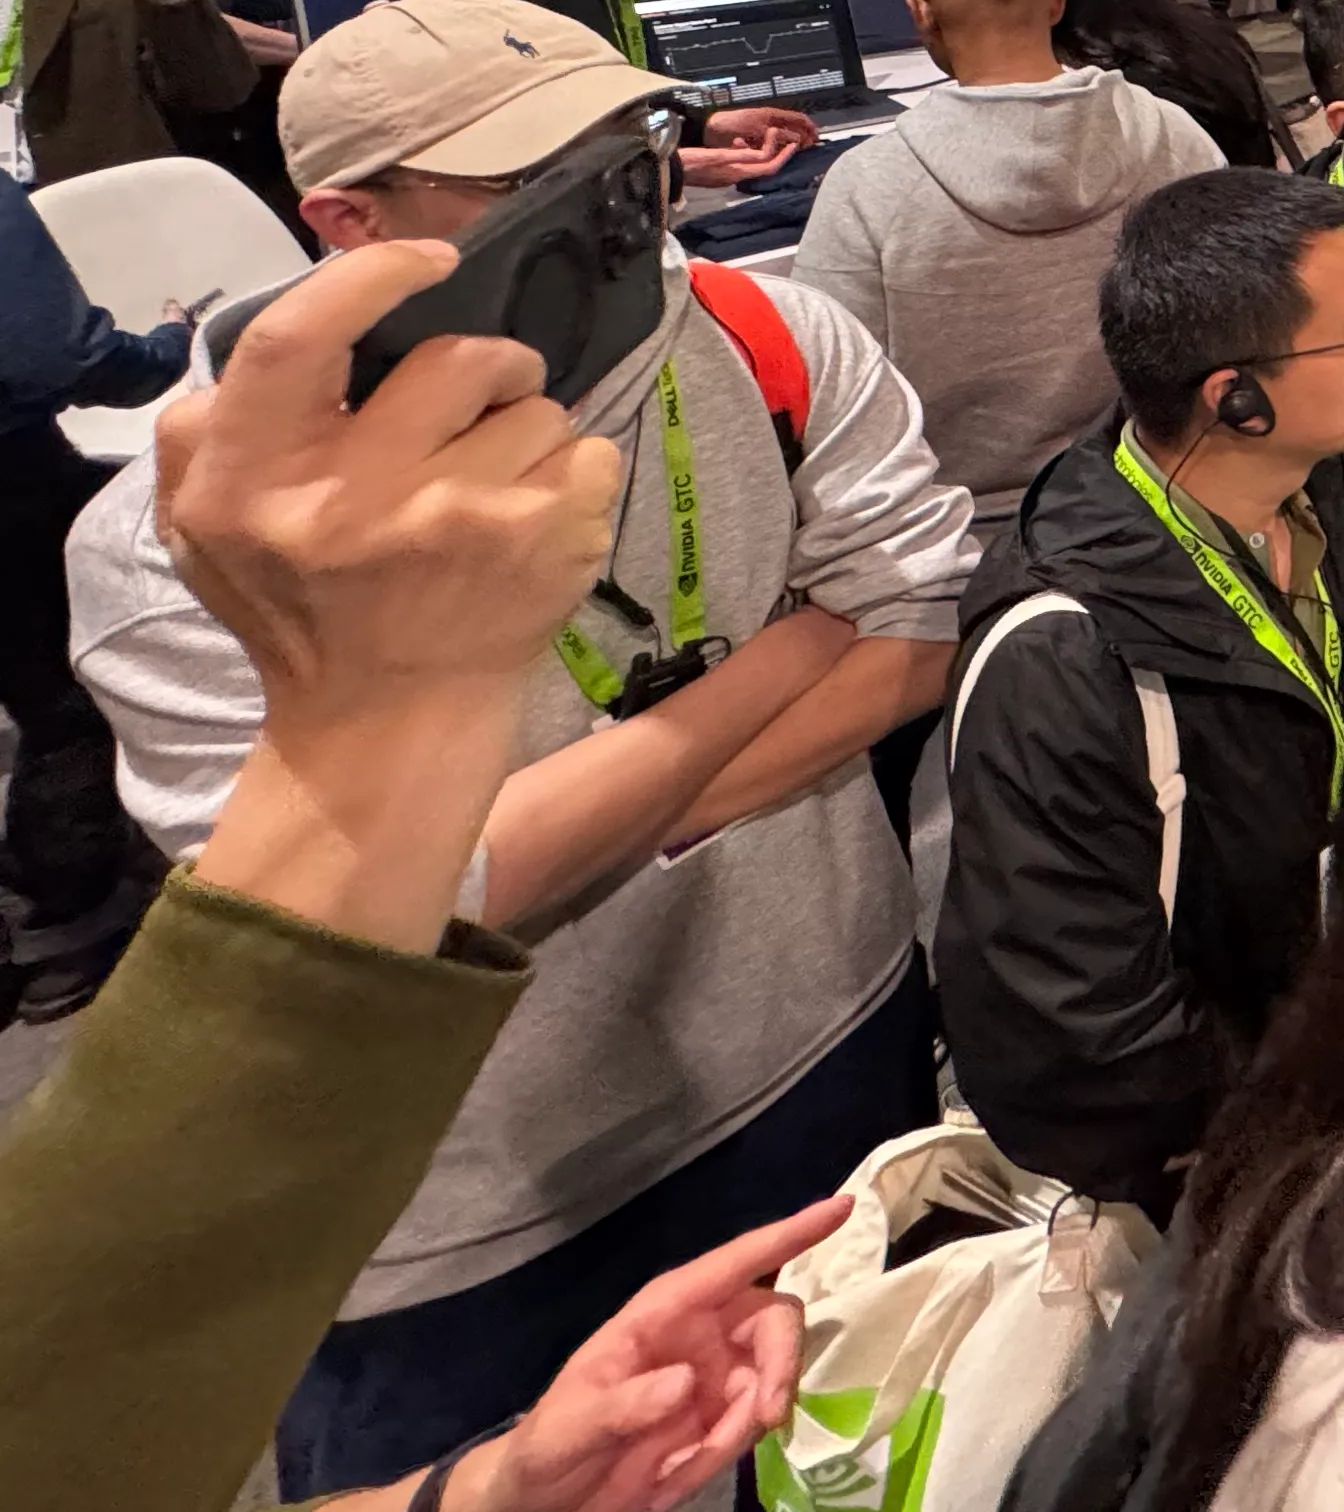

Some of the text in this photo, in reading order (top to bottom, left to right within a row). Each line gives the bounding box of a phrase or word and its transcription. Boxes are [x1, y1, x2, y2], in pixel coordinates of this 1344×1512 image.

[676, 472, 695, 513] GTC
[1232, 594, 1264, 631] GTC
[1328, 631, 1342, 669] GTC
